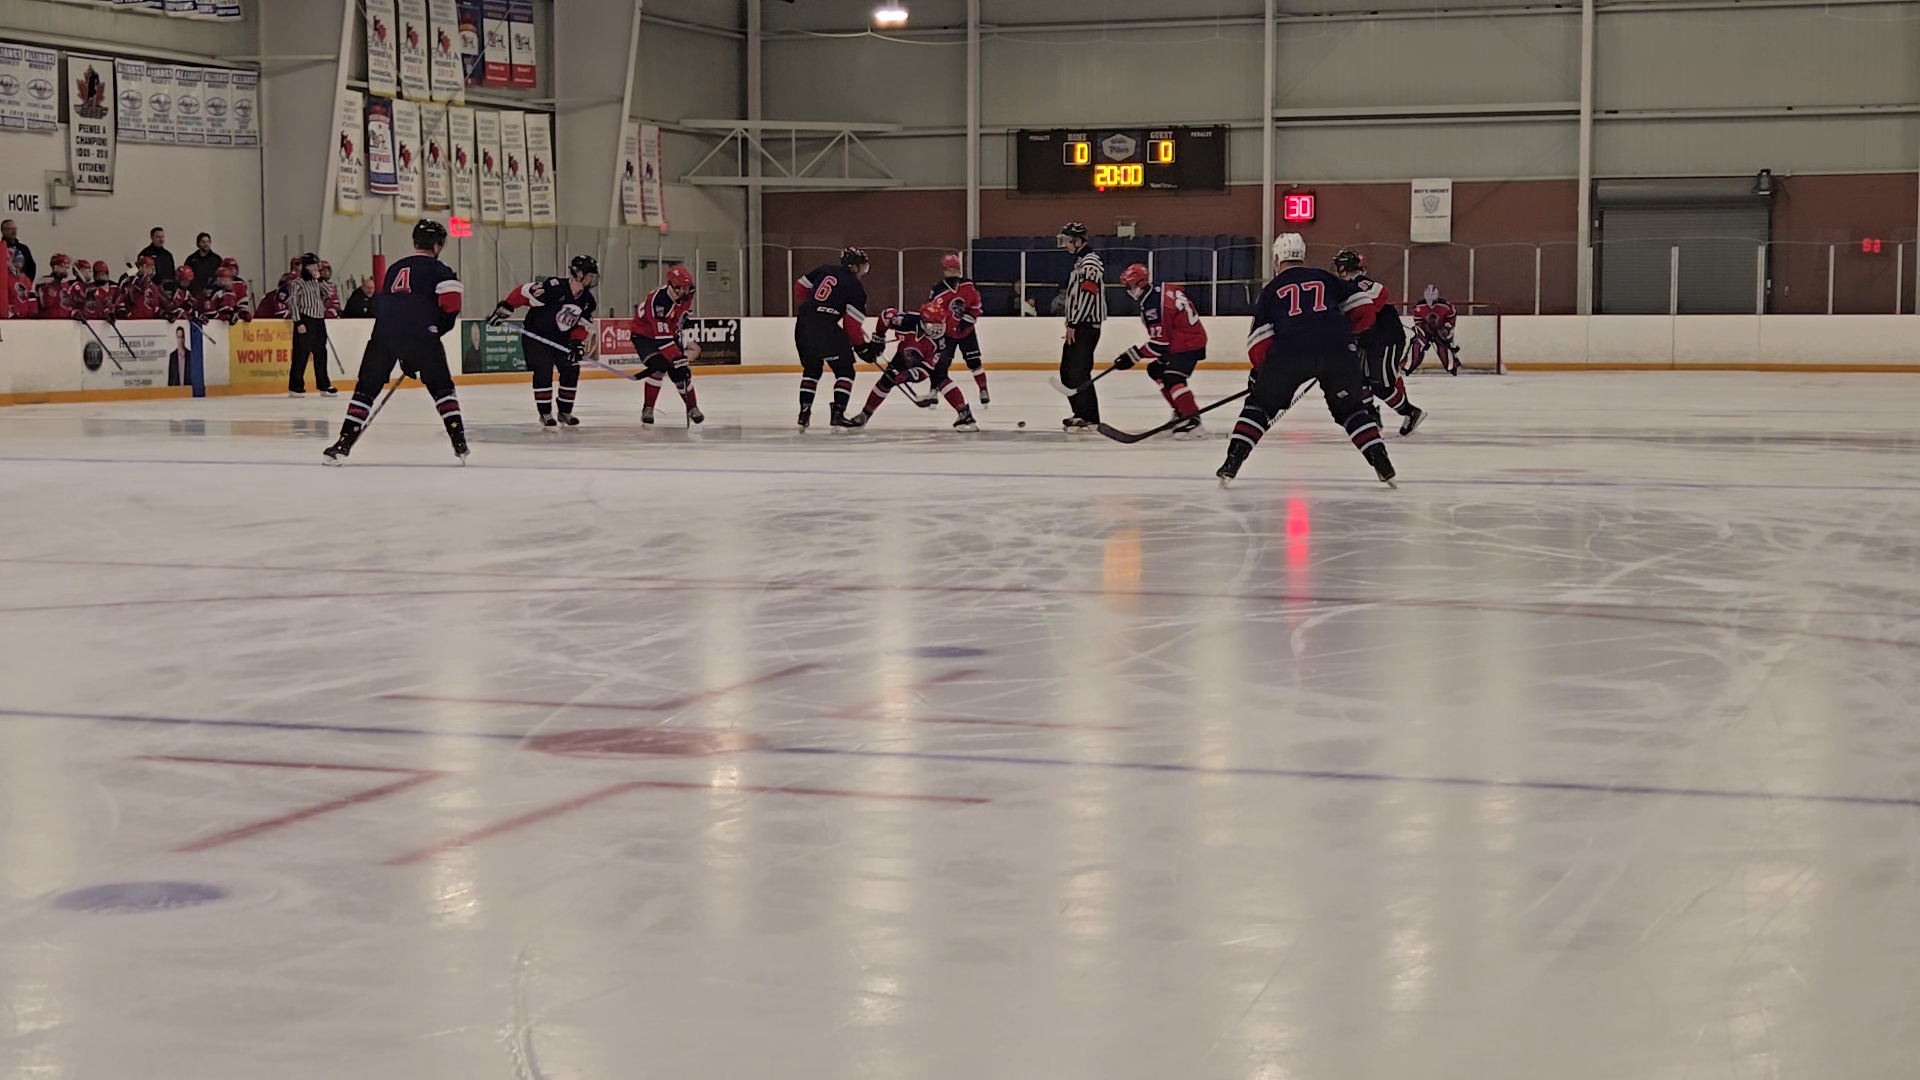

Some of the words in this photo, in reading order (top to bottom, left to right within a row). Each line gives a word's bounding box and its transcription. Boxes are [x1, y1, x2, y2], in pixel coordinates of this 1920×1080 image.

[1150, 131, 1173, 139] GUEST
[1077, 143, 1088, 163] 0
[1161, 141, 1172, 161] 0
[1096, 165, 1142, 185] 20:00
[8, 194, 39, 212] HOME
[1289, 198, 1311, 217] 30
[391, 267, 411, 293] 4
[814, 275, 838, 301] 6
[1276, 280, 1328, 317] 77
[243, 329, 254, 342] No
[702, 318, 738, 343] hair?
[237, 349, 273, 363] WON'T
[276, 349, 288, 362] BE
